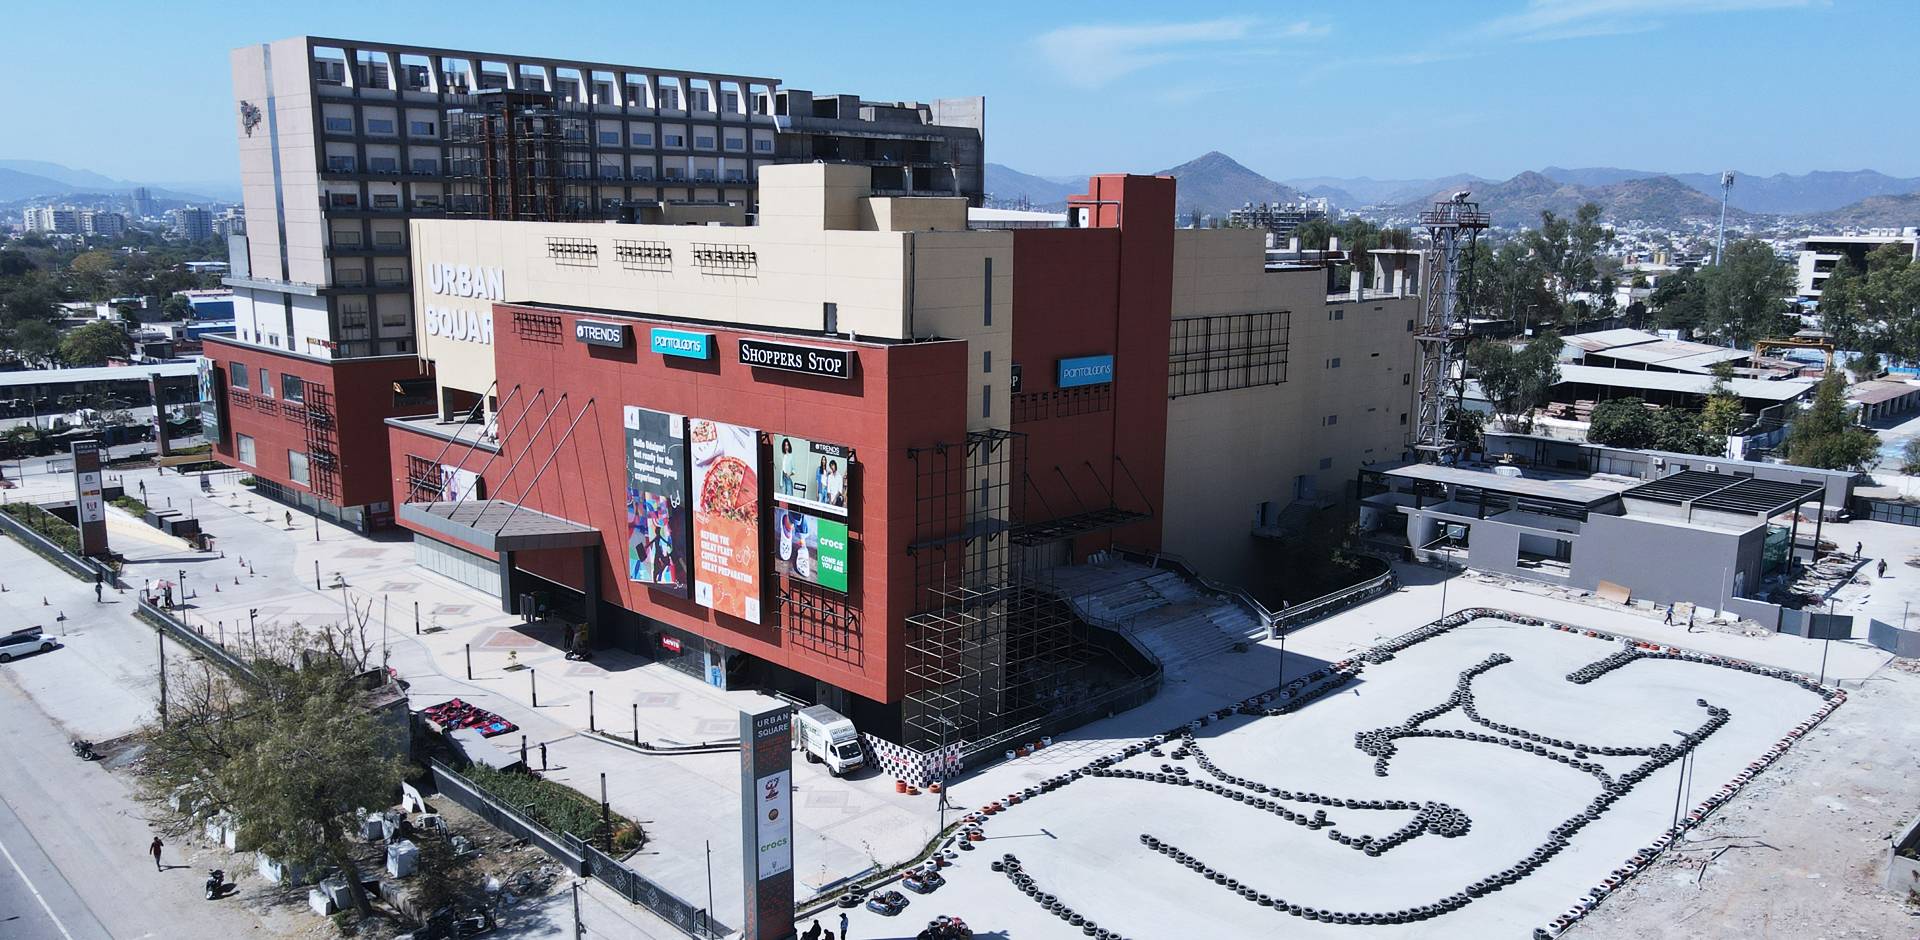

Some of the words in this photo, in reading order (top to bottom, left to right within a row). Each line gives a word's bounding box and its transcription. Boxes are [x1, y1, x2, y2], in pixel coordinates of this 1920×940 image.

[428, 262, 506, 302] URBAN
[584, 326, 621, 344] TRENDS
[820, 445, 840, 454] TRENDS
[642, 452, 656, 464] ready
[656, 454, 665, 464] for
[665, 456, 674, 466] the
[634, 473, 661, 485] experience
[655, 466, 678, 480] shopping
[701, 530, 719, 543] BEFORE
[719, 535, 730, 546] THE
[820, 537, 844, 551] crocs
[701, 551, 718, 563] COMES
[718, 556, 729, 567] THE
[820, 555, 837, 566] COME
[836, 560, 844, 568] AS
[821, 561, 833, 571] YOU
[833, 564, 844, 574] ARE
[717, 566, 753, 584] PREPARATION
[756, 712, 789, 728] URBAN
[757, 723, 789, 738] SQUARE
[890, 754, 910, 767] KARTING
[760, 837, 788, 853] crocs
